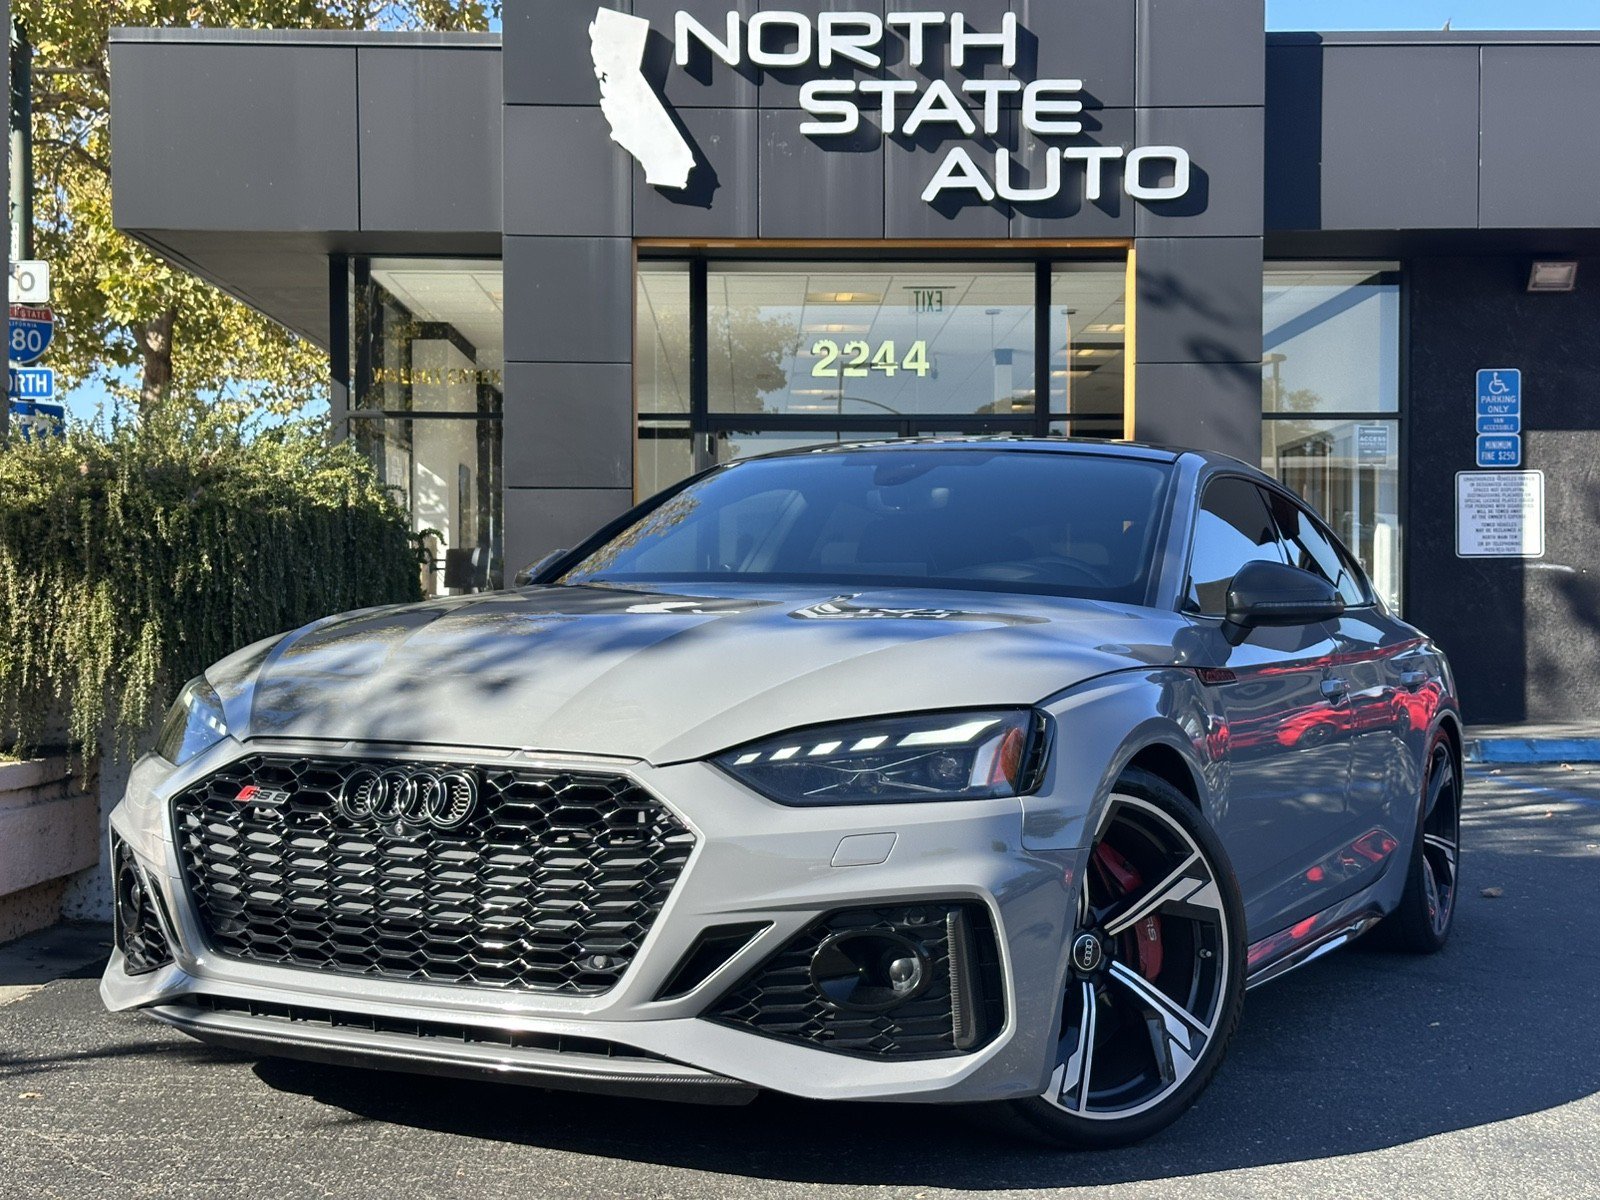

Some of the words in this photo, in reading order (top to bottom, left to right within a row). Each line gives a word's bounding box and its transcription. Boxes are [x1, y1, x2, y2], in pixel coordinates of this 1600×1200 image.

[674, 10, 1017, 69] NORTH
[799, 78, 1084, 137] STATE
[920, 145, 1191, 203] AUTO
[9, 328, 41, 352] 80
[811, 339, 930, 377] 2244
[9, 373, 47, 393] RTH
[1480, 395, 1516, 404] PARKING
[1487, 405, 1509, 413] ONLY
[1485, 440, 1512, 449] MINIMUM
[1481, 451, 1496, 460] FINE
[1498, 451, 1516, 461] $250
